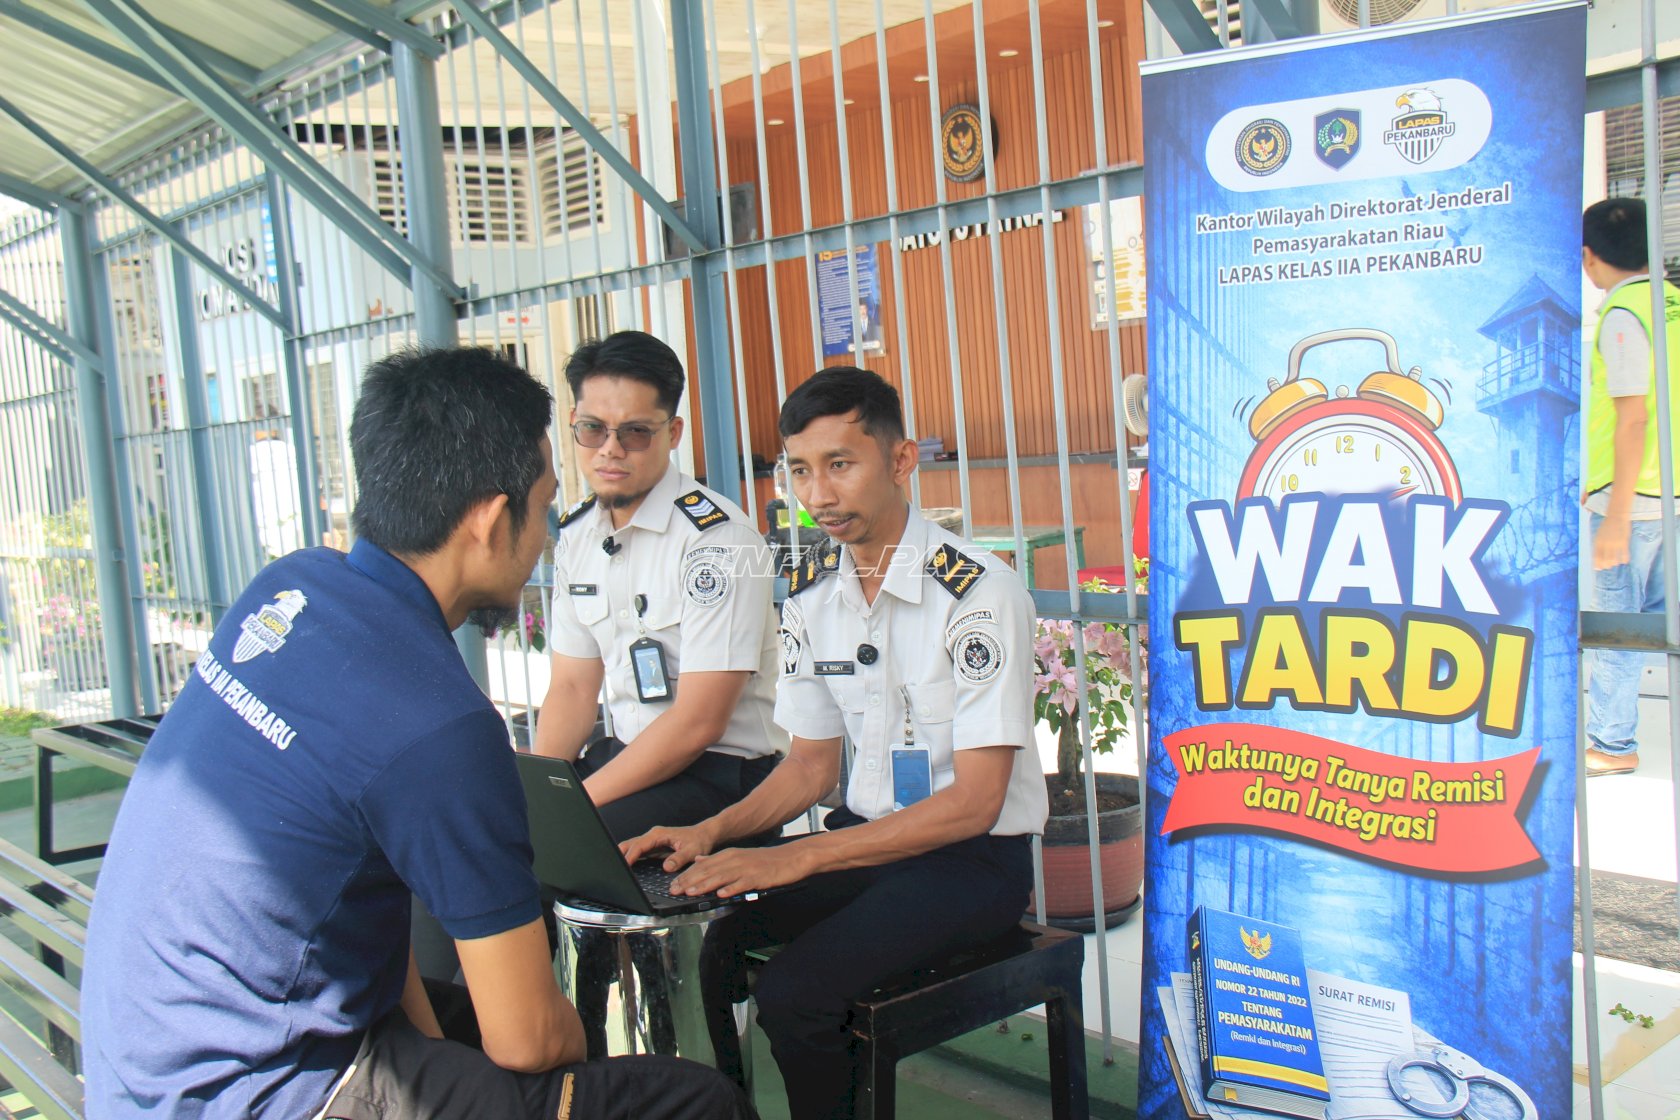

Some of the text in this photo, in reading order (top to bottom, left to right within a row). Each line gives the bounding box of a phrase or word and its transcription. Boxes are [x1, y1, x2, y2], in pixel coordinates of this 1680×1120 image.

[1386, 125, 1452, 142] PEKANBARU
[1398, 116, 1440, 128] LAPAS
[1198, 183, 1511, 234] Kantor Wilayah Direktorat Jenderal
[1253, 222, 1444, 256] Pemasyarakatan Riau
[1218, 246, 1483, 285] LAPAS KELAS IIA PEKANBARU
[1303, 448, 1318, 468] 11
[1335, 435, 1355, 455] 12
[1374, 444, 1380, 462] 1
[1280, 473, 1299, 493] 10
[1399, 465, 1412, 485] 2
[698, 512, 724, 526] IMIPAS
[1194, 500, 1503, 616] WAK
[954, 566, 979, 594] IMIPAS
[260, 612, 286, 635] LAPAS
[210, 670, 232, 695] IIA
[1179, 614, 1527, 731] TARDI
[220, 679, 297, 750] PEKANBARU
[1179, 742, 1505, 803] Waktunya Tanya Remisi
[1243, 777, 1438, 842] dan Integrasi
[1214, 958, 1289, 985] UNDANG-UNDANG
[1291, 976, 1300, 986] RI
[1216, 979, 1307, 1007] NOMOR 22 TAHUN 2022
[1318, 984, 1396, 1013] SURAT REMISI
[1242, 1001, 1282, 1018] TENTANG
[1218, 1011, 1313, 1040] PEMASYARAKATAM
[1258, 1034, 1271, 1046] dan
